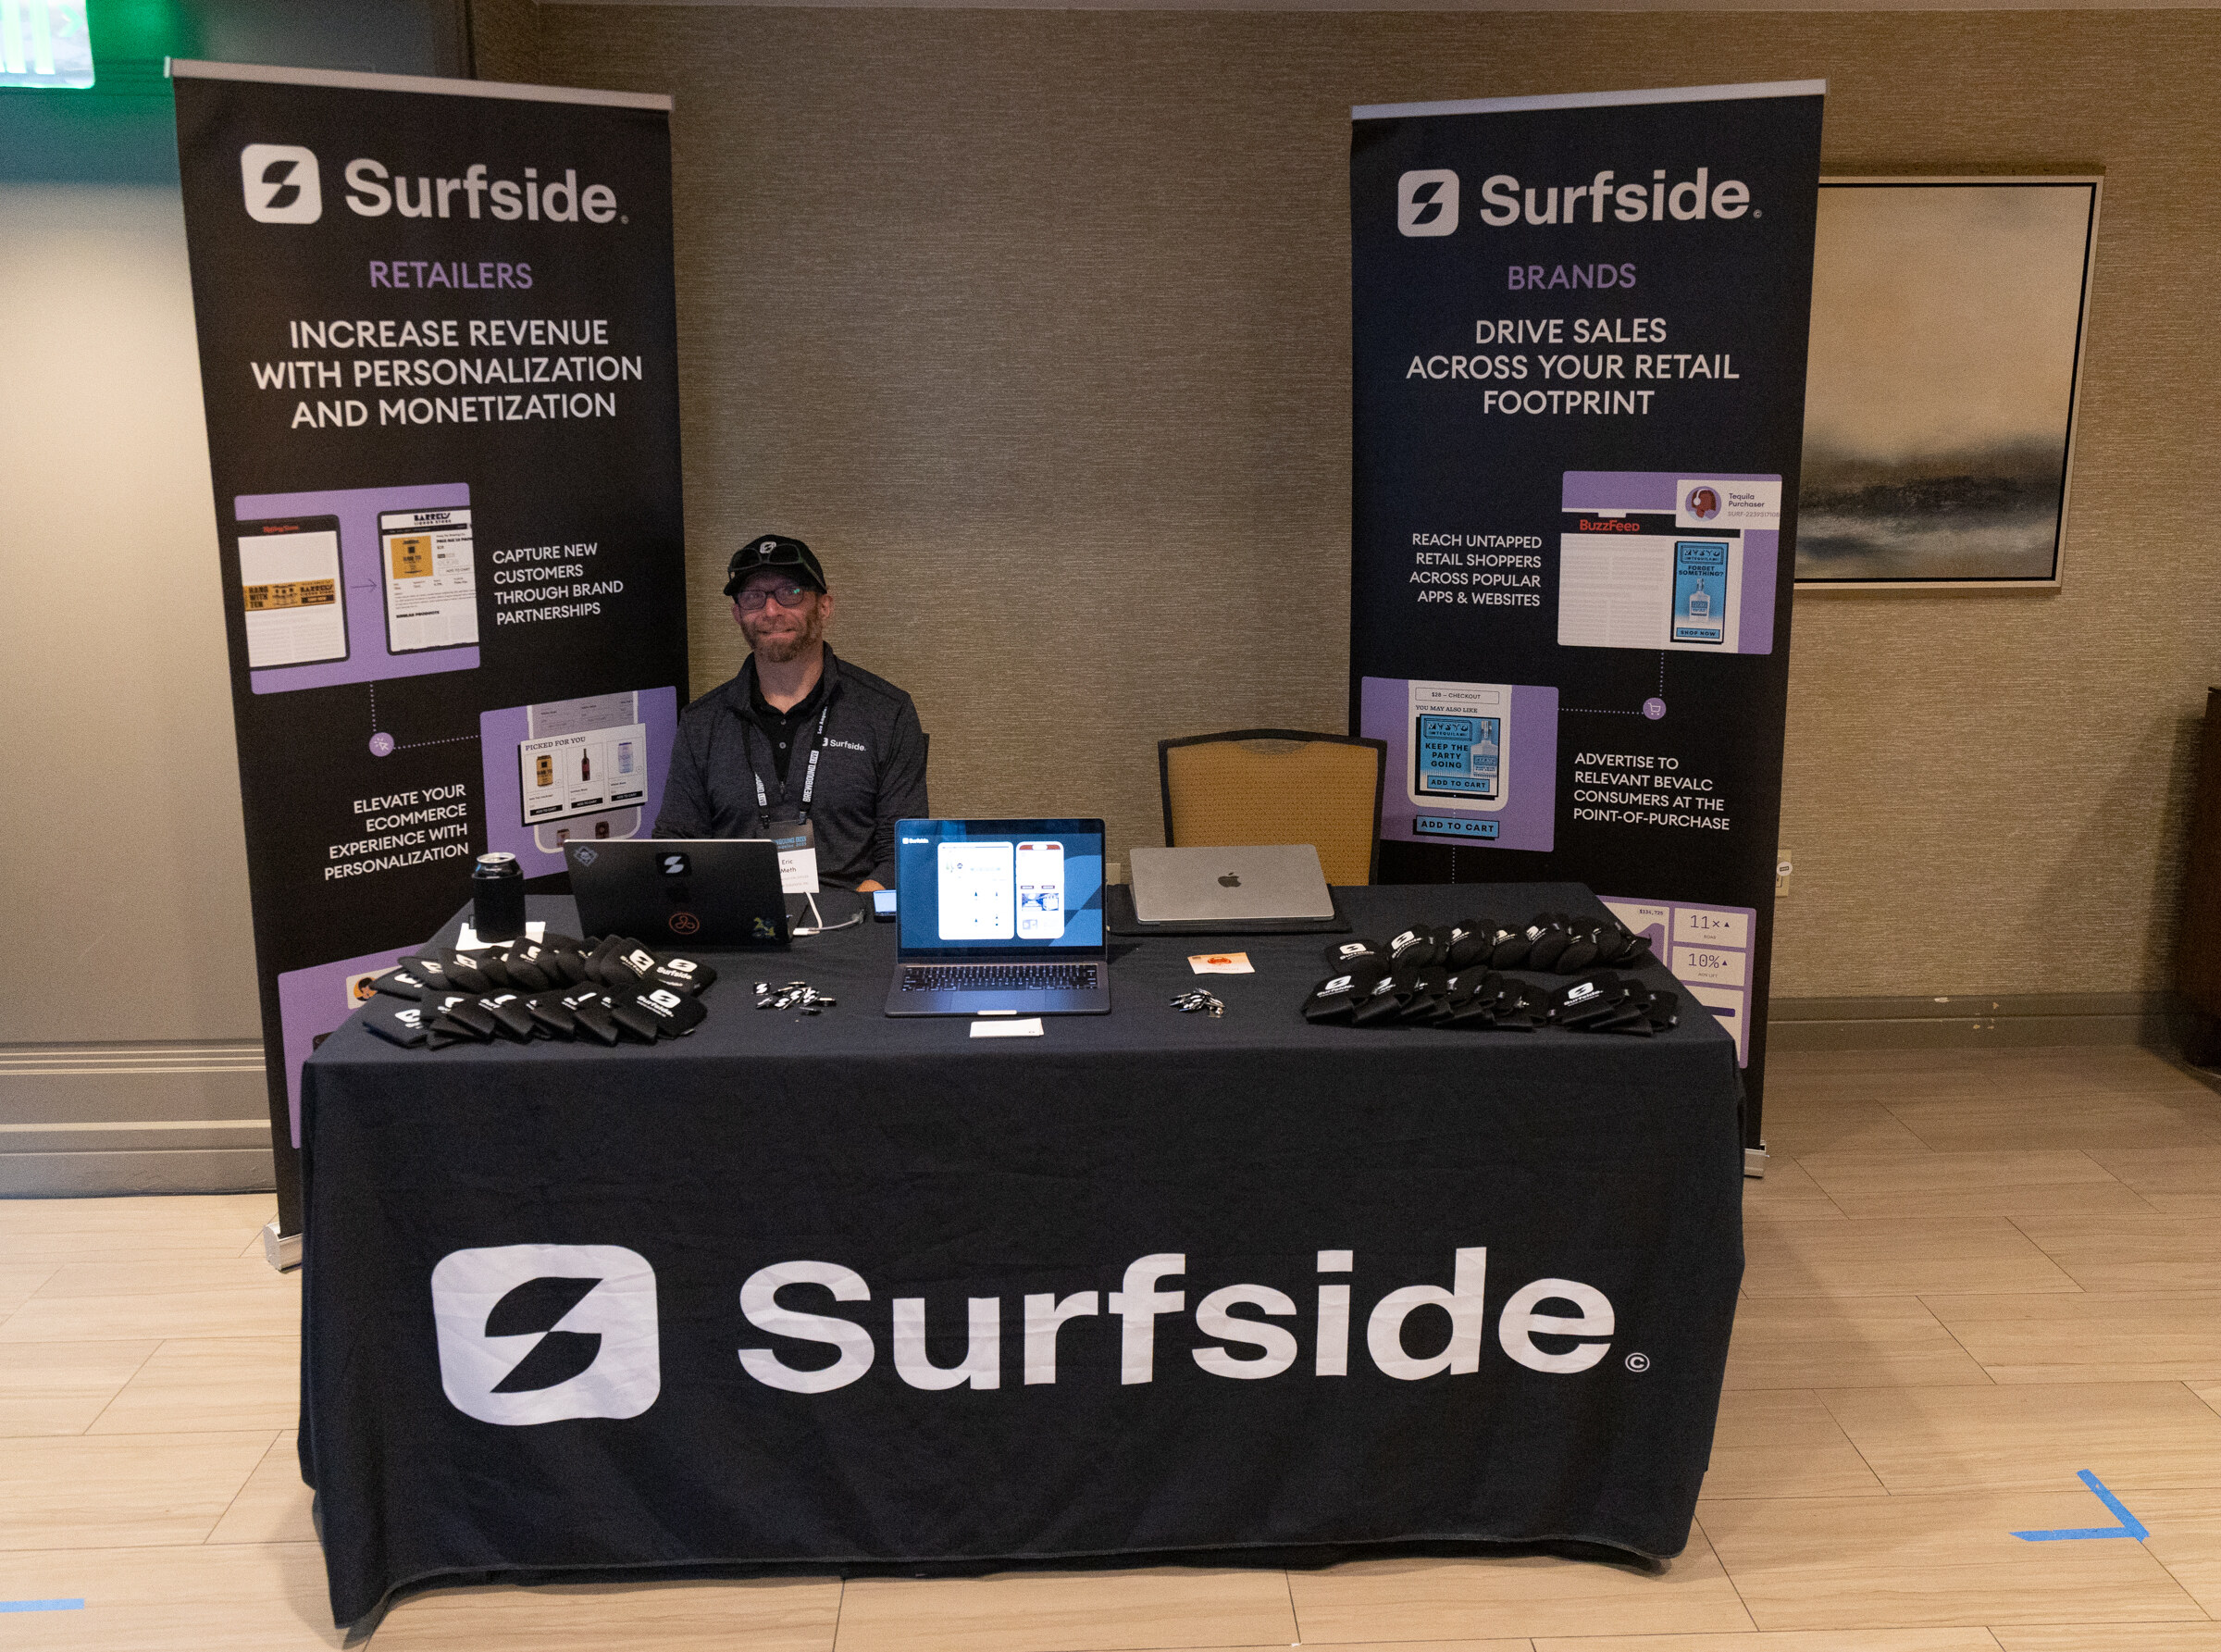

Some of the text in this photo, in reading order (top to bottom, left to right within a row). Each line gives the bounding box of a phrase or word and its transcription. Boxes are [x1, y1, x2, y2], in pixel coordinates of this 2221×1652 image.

[345, 158, 616, 223] Surfside
[1481, 168, 1749, 226] Surfside
[370, 261, 532, 289] RETAILERS
[1508, 263, 1635, 290] BRANDS
[291, 320, 608, 348] INCREASE REVENUE
[1476, 318, 1666, 343] DRIVE SALES
[251, 356, 641, 389] WITH PERSONALIZATION
[1407, 354, 1739, 379] ACROSS YOUR RETAIL
[292, 392, 615, 429] AND MONETIZATION
[1484, 391, 1655, 414] FOOTPRINT
[1413, 533, 1542, 548] REACH UNTAPPED
[492, 542, 597, 564] CAPTURE NEW
[1417, 553, 1541, 568] RETAIL SHOPPERS
[494, 565, 583, 585] CUSTOMERS
[1409, 572, 1541, 587] ACROSS POPULAR
[494, 586, 568, 604] THROUGH
[573, 580, 623, 597] BRAND
[1418, 590, 1540, 606] APPS & WEBSITES
[496, 602, 601, 625] PARTNERSHIPS
[525, 742, 553, 751] PICKED
[1575, 752, 1679, 770] ADVERTISE TO
[1575, 771, 1712, 791] RELEVANT BEVALC
[354, 784, 465, 814] ELEVATE YOUR
[1574, 789, 1724, 811] CONSUMERS AT THE
[366, 804, 466, 833] ECOMMERCE
[1466, 824, 1494, 832] CART
[1573, 808, 1730, 830] POINT-OF-PURCHASE
[329, 824, 467, 860] EXPERIENCE WITH
[325, 842, 468, 880] PERSONALIZATION
[1688, 953, 1720, 968] 10%
[738, 1247, 1615, 1394] Surfside
